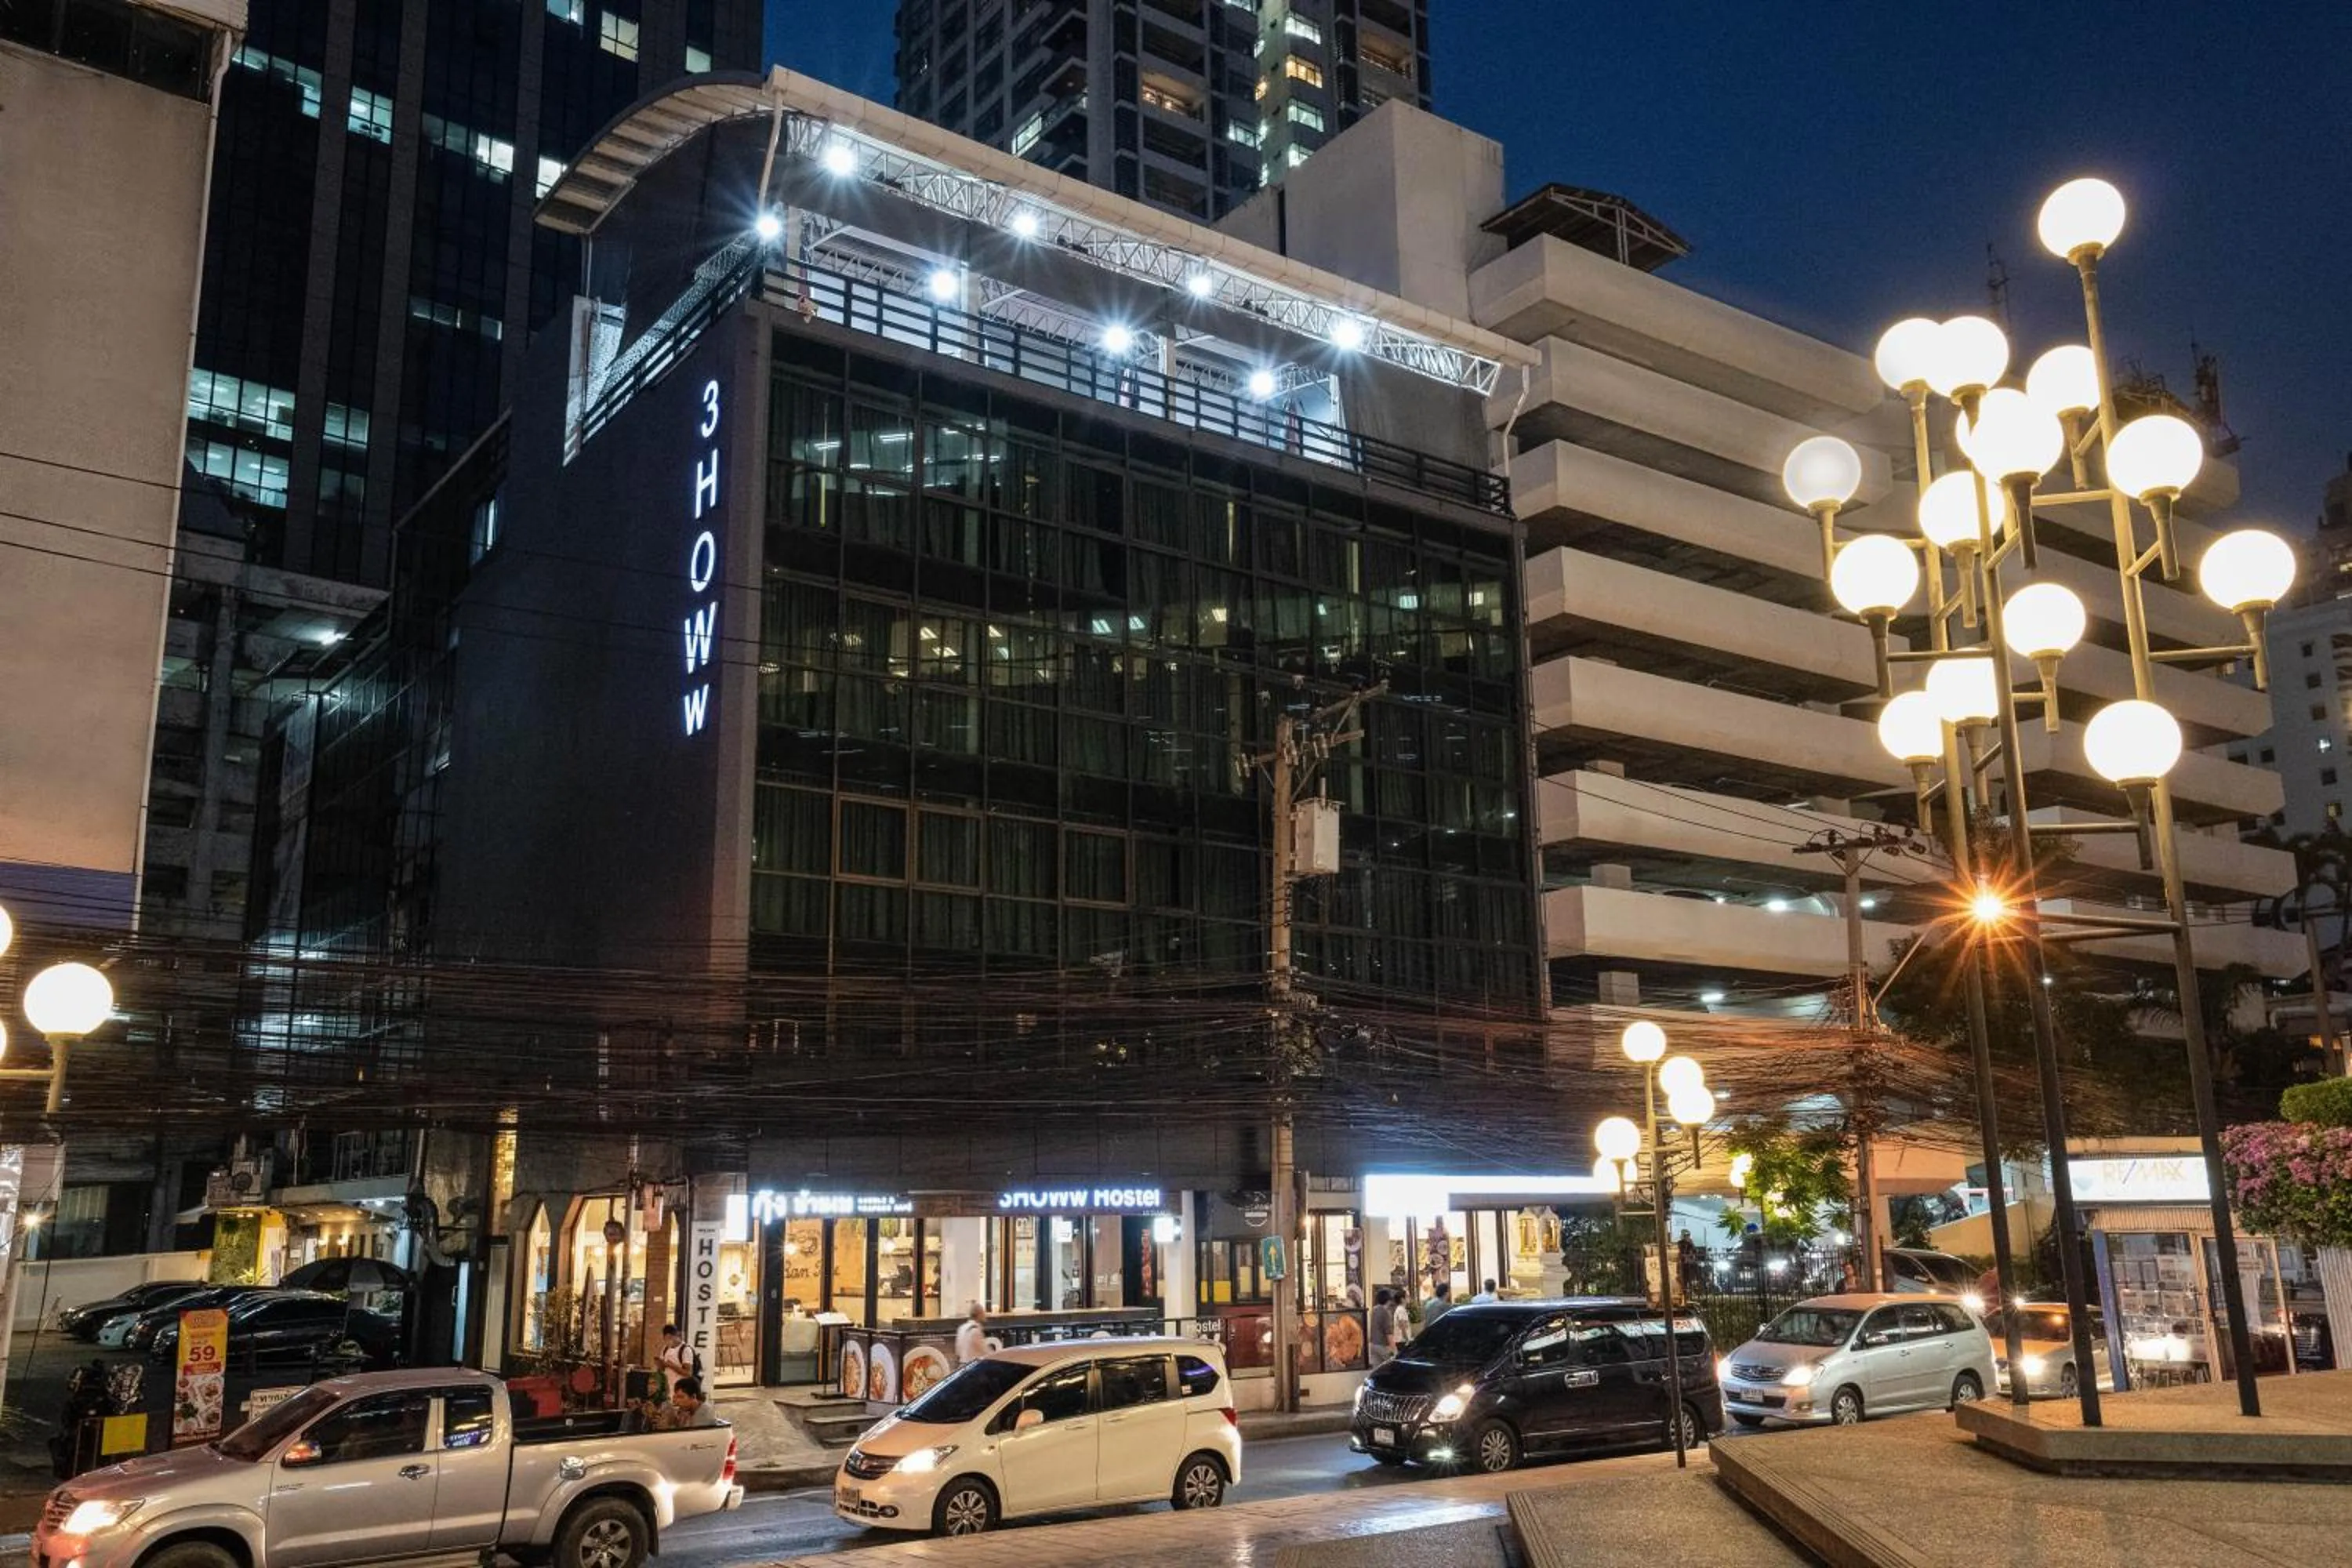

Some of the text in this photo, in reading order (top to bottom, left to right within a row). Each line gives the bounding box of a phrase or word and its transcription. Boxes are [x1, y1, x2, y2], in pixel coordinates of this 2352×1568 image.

[684, 380, 719, 736] 3HOWW
[694, 1239, 714, 1348] HOSTE
[188, 1345, 216, 1362] 59
